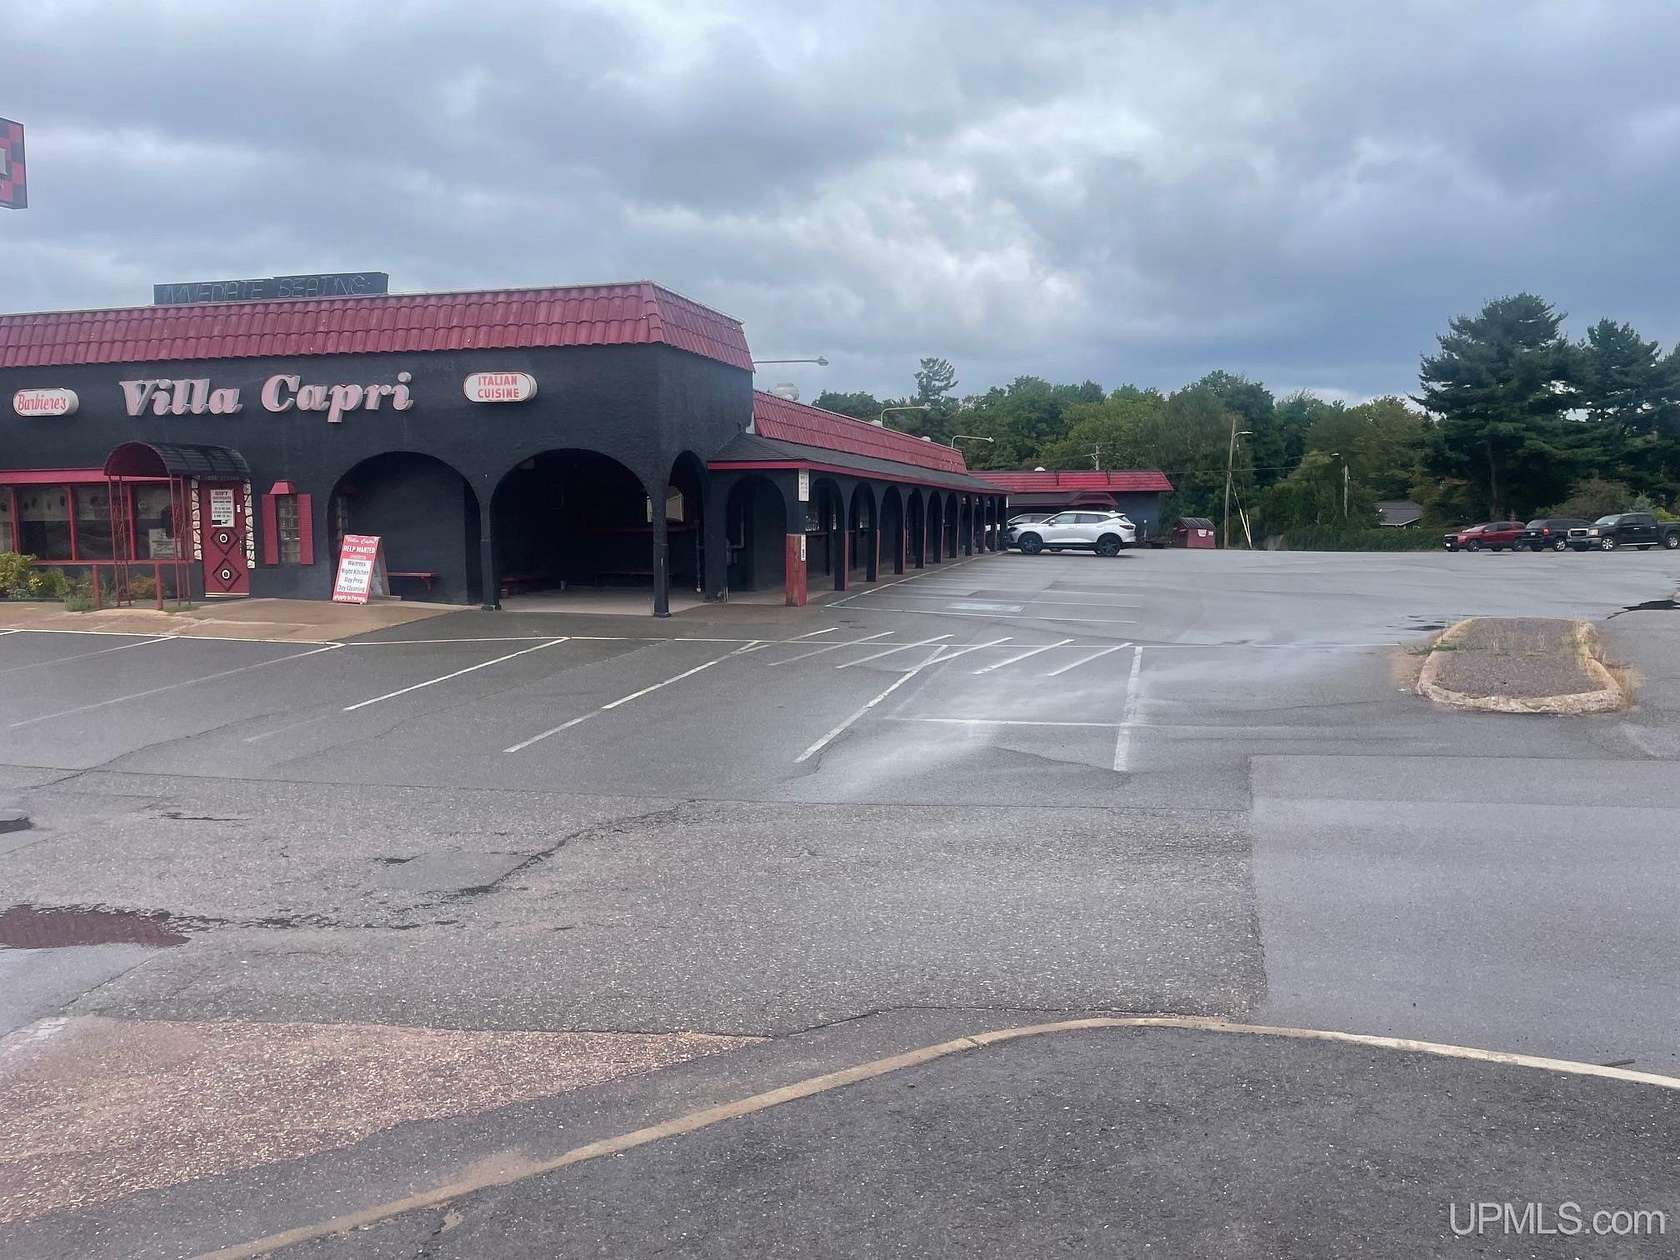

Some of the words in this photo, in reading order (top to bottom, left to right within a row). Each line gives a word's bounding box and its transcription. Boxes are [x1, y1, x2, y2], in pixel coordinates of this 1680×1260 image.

[478, 375, 518, 386] ITALIAN
[119, 378, 242, 416] Villa
[261, 371, 413, 423] Capri
[477, 388, 520, 399] CUISINE
